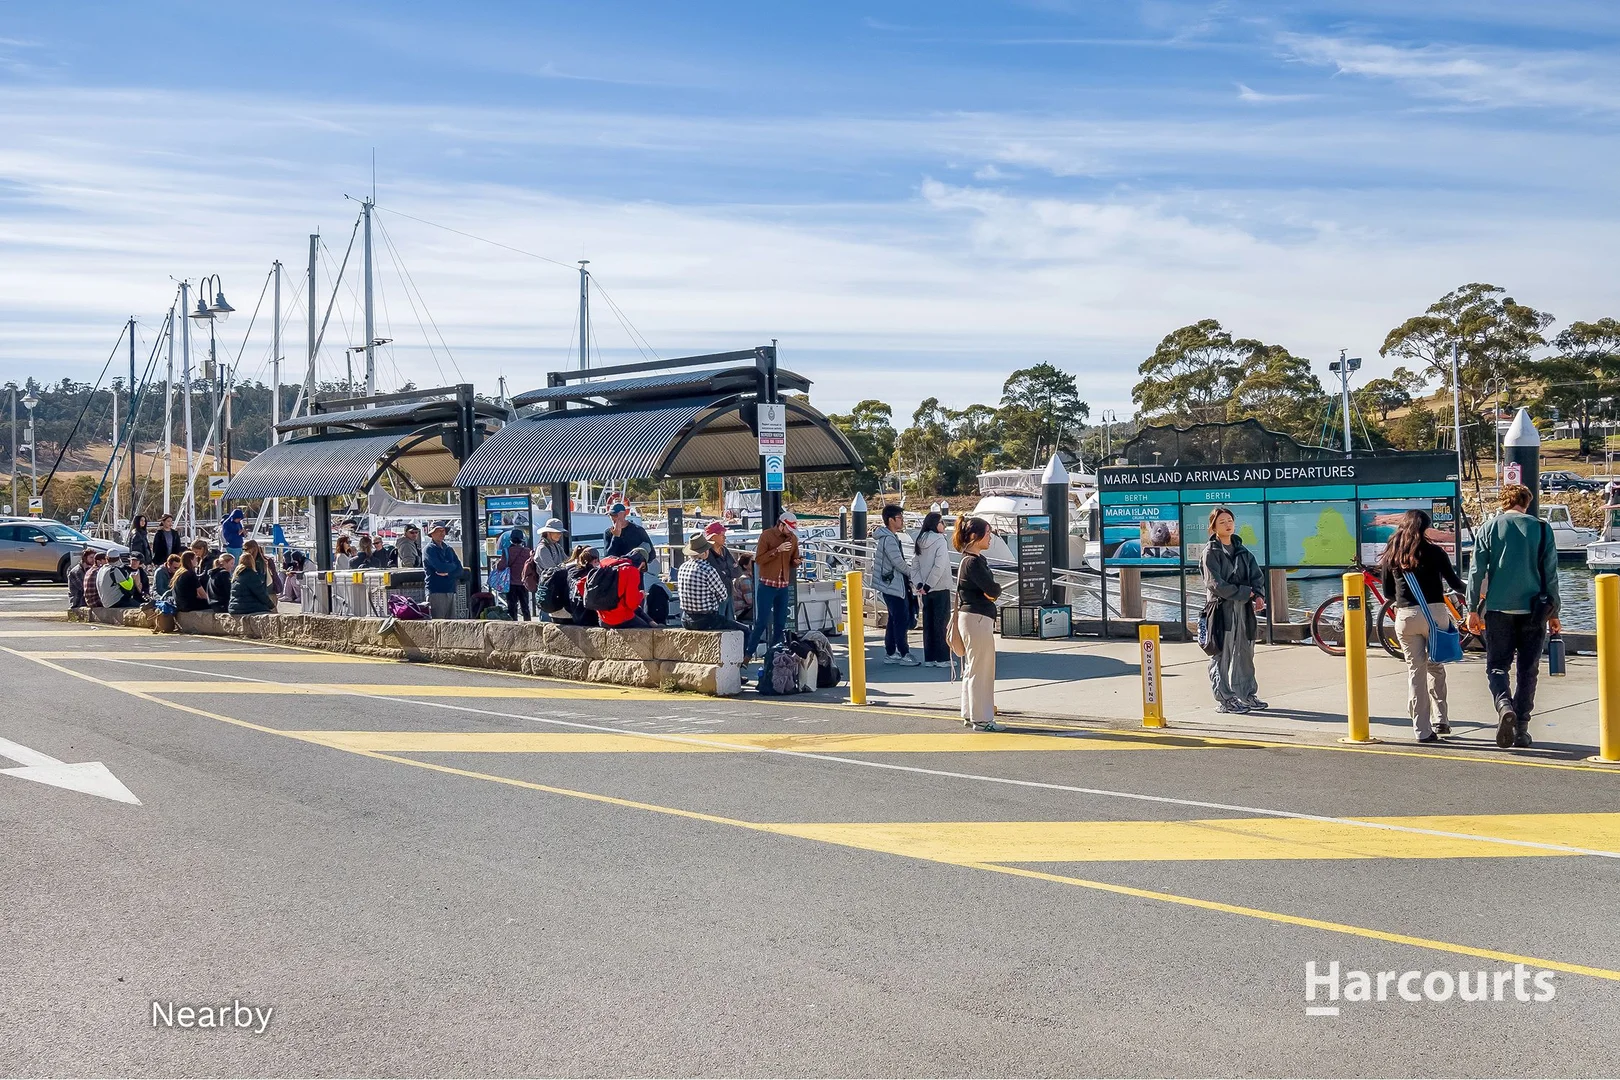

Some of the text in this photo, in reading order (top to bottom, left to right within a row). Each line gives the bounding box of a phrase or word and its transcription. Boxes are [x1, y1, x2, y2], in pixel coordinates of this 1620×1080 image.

[1103, 465, 1355, 485] MARIA ISLAND ARRIVALS AND DEPARTURES
[1124, 494, 1148, 502] BERTH
[1205, 492, 1231, 500] BERTH
[1105, 508, 1132, 517] MARIA
[1132, 507, 1160, 516] ISLAND
[1147, 654, 1152, 664] NO
